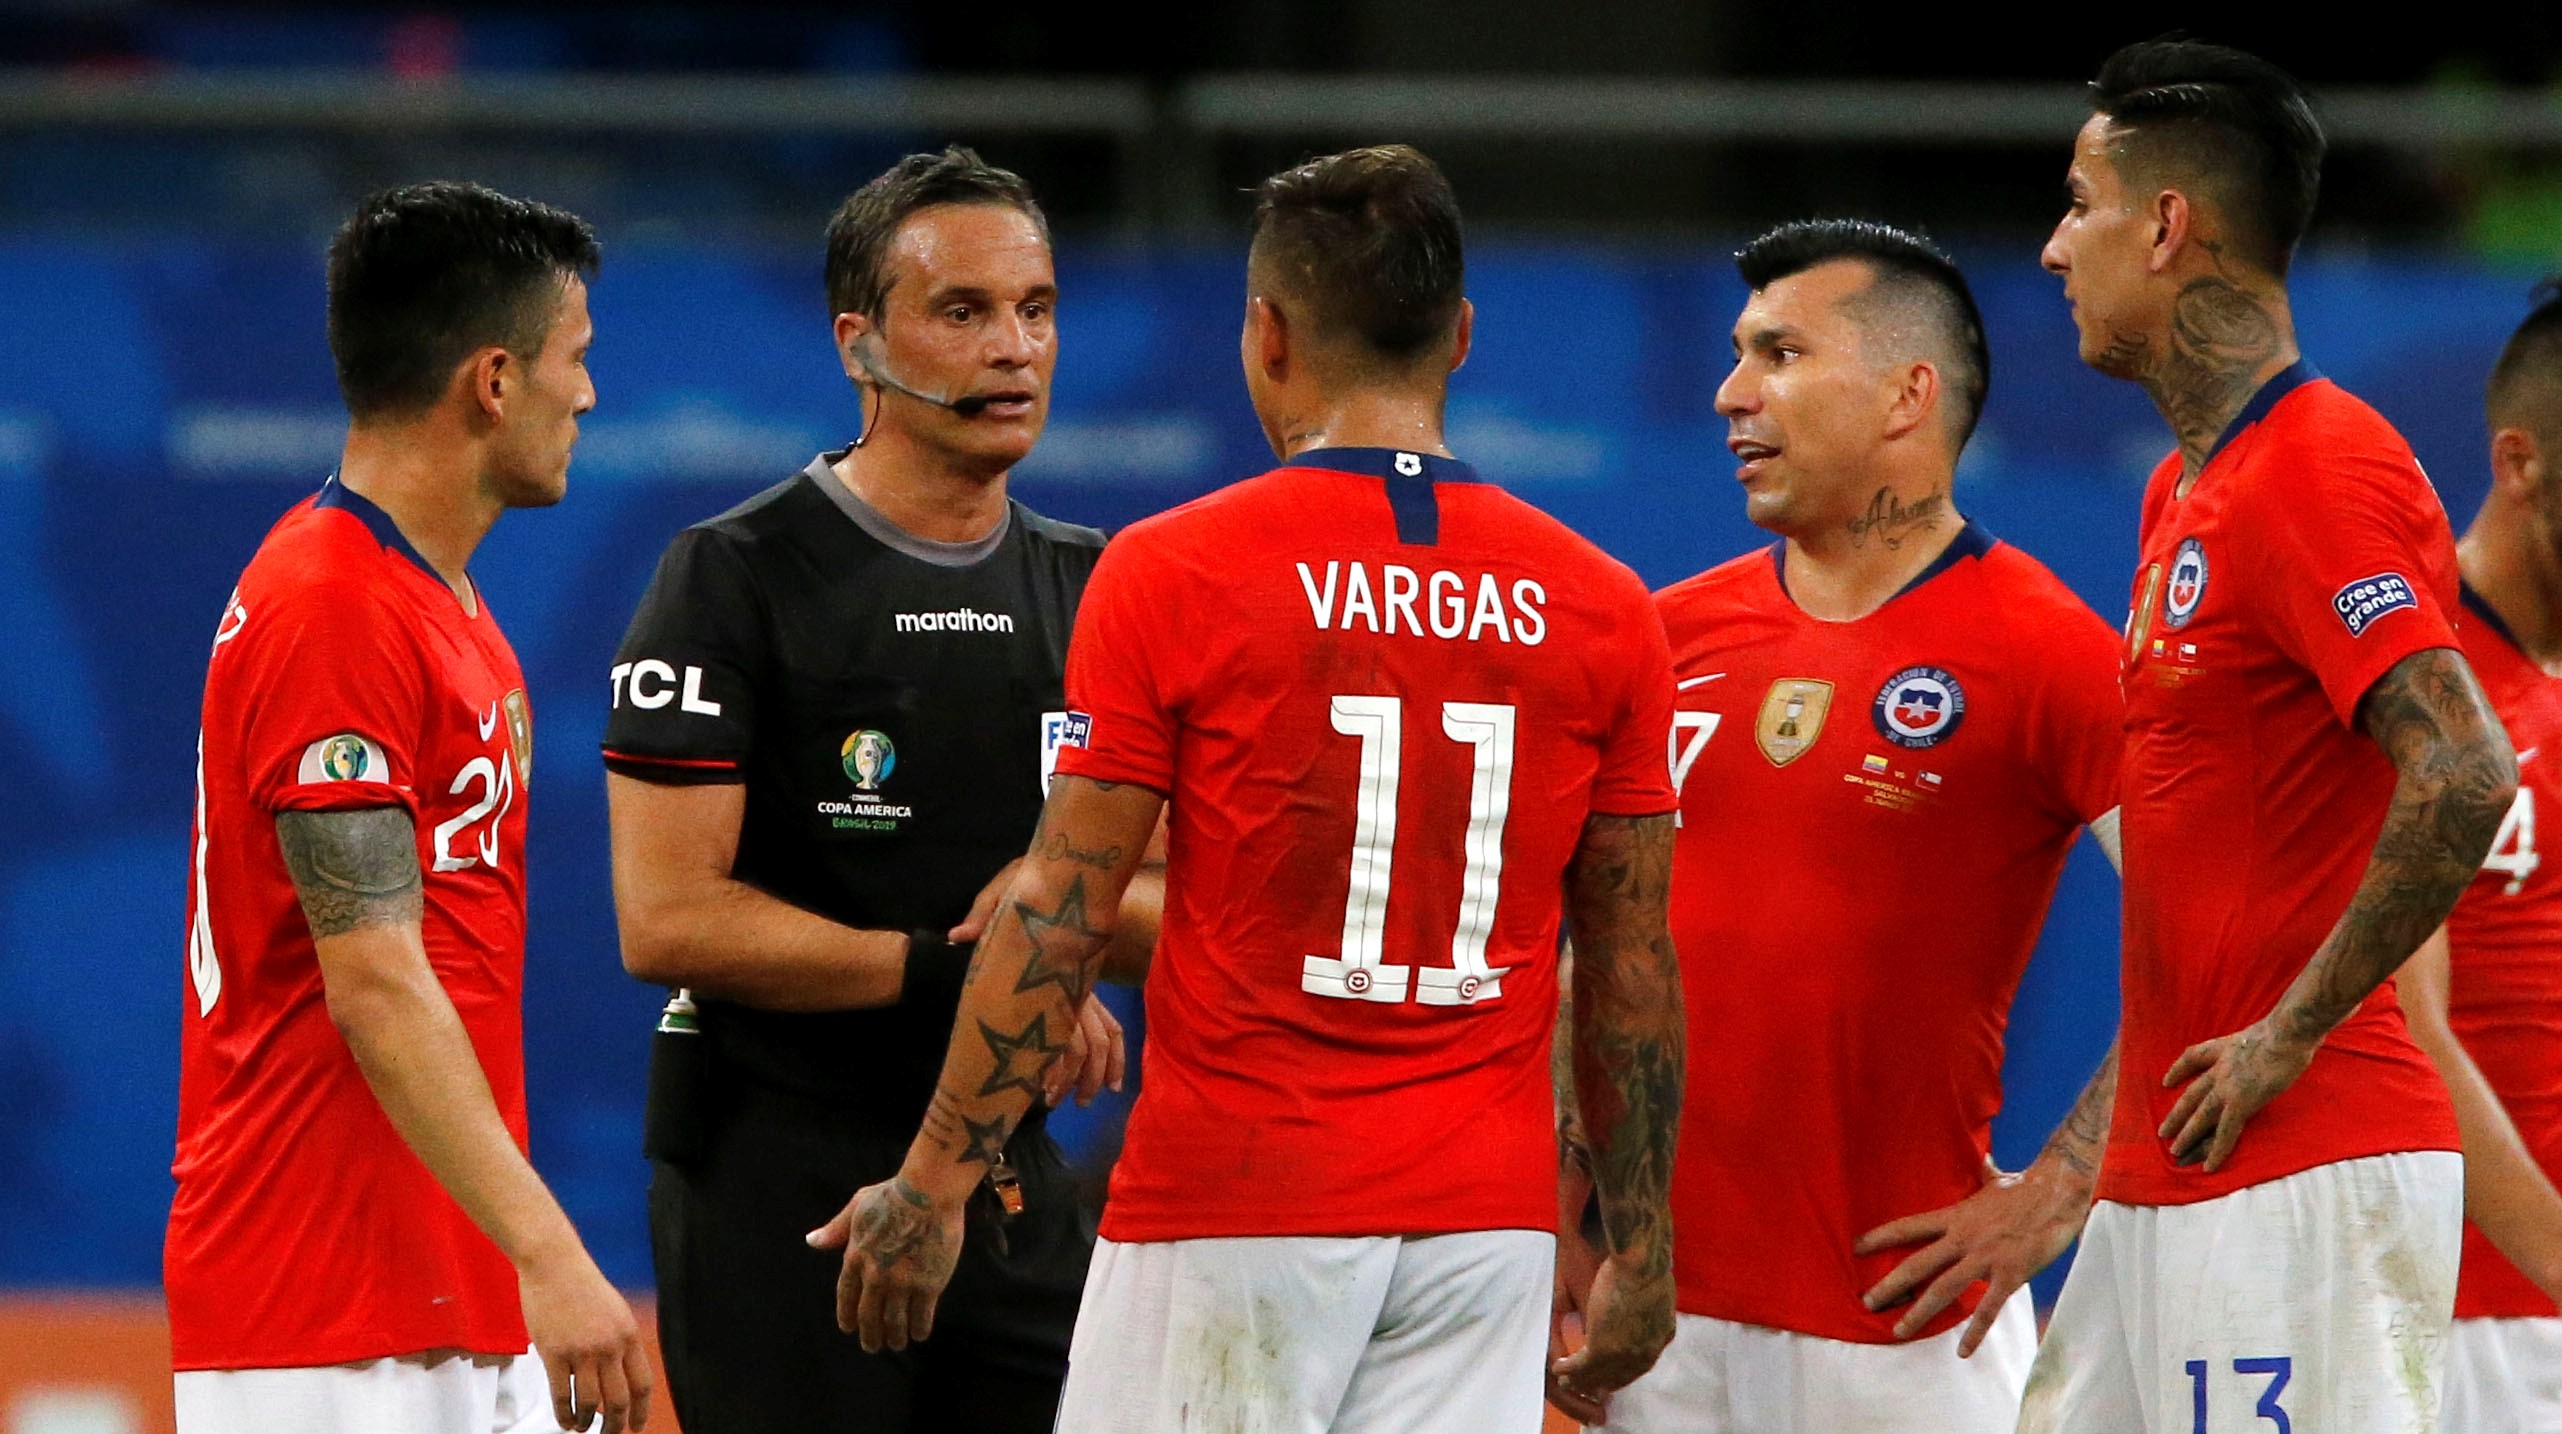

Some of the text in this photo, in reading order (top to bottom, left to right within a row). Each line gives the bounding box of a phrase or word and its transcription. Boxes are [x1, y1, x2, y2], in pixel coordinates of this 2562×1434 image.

[895, 607, 1014, 633] marathon
[1296, 560, 1547, 646] VARGAS
[2337, 578, 2404, 613] Cree en
[2347, 590, 2407, 631] grande
[610, 659, 721, 717] TCL
[432, 748, 514, 873] 20
[817, 802, 912, 818] COPA AMERICA
[832, 817, 897, 831] BRASIL 2019
[1301, 695, 1516, 1006] 11
[2185, 1356, 2292, 1434] 13
